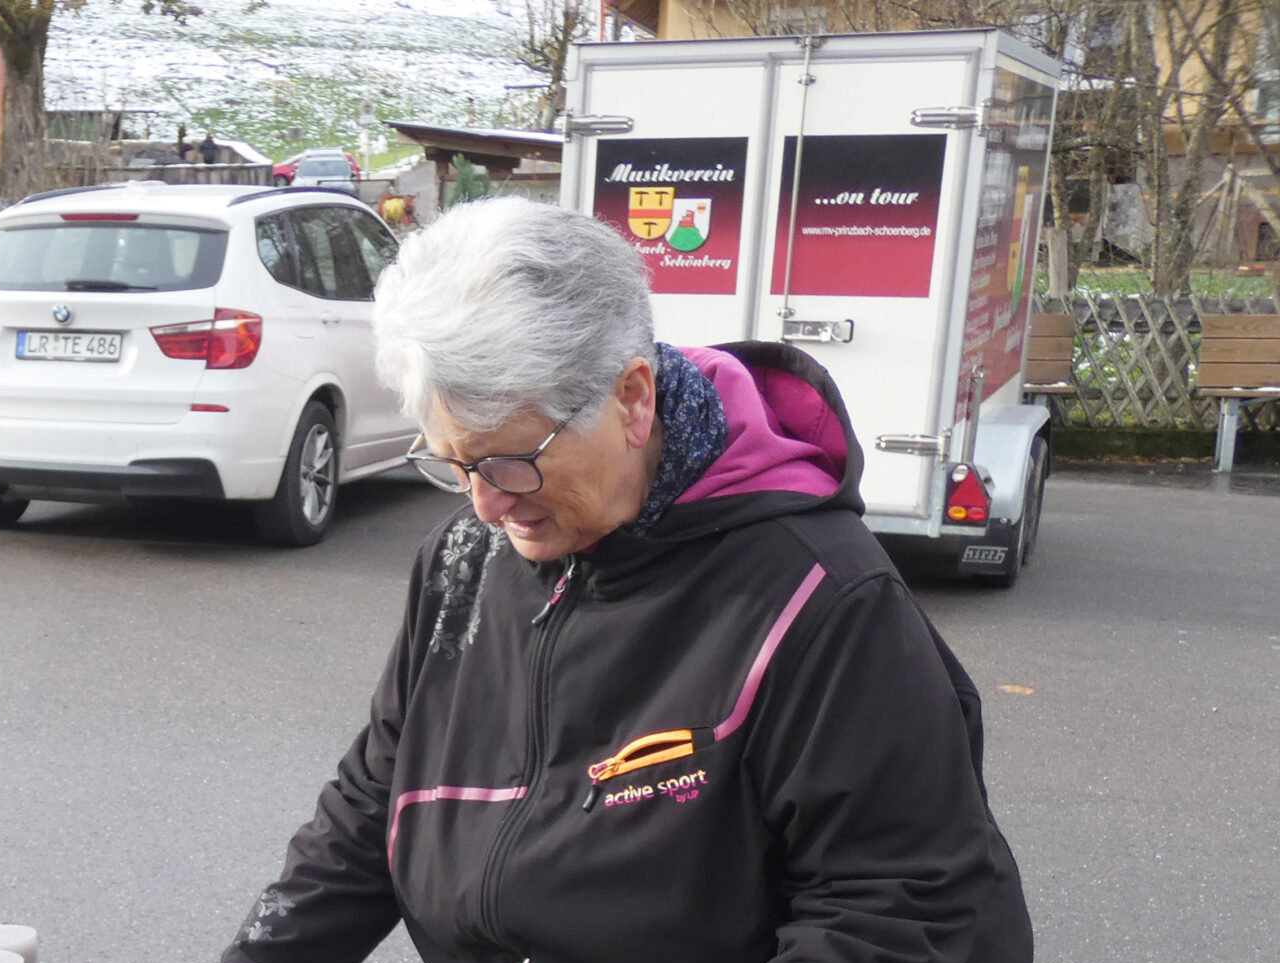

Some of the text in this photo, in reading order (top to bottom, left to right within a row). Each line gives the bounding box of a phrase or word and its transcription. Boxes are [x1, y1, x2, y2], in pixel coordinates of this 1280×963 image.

[604, 163, 735, 183] Musikverein
[869, 188, 919, 205] tour
[801, 226, 932, 239] www.mv-prinzbach-schoenberg.de
[659, 255, 732, 270] Schönberg
[27, 335, 118, 355] LR TE 486
[605, 769, 709, 807] active sport
